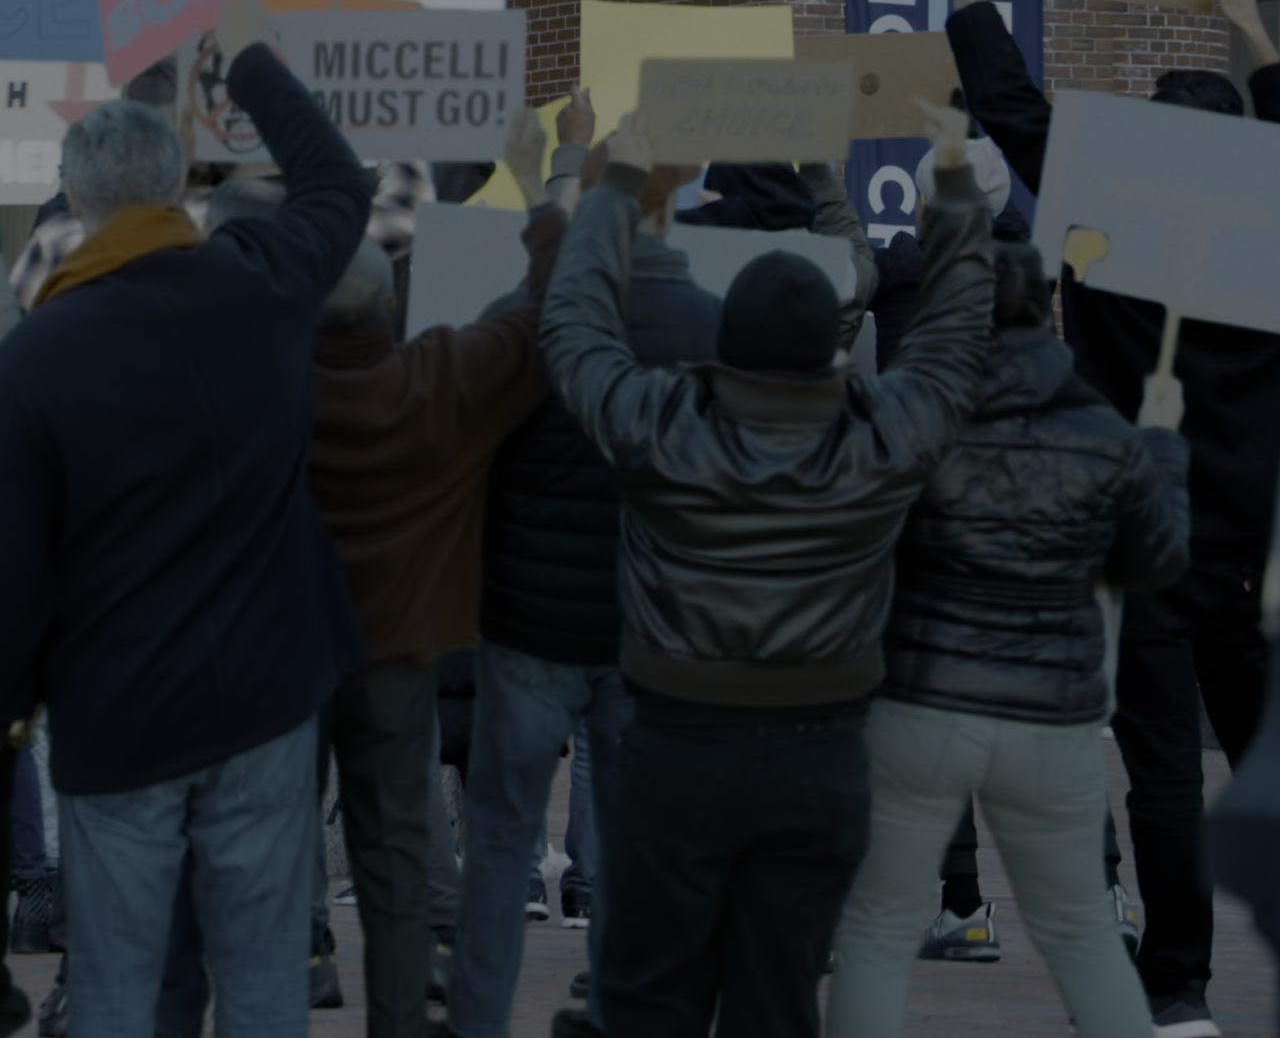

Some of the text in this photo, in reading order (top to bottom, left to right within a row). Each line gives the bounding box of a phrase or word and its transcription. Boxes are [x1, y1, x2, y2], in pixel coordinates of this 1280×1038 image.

[313, 40, 509, 81] MICCELLI
[314, 89, 507, 128] MUST GO!
